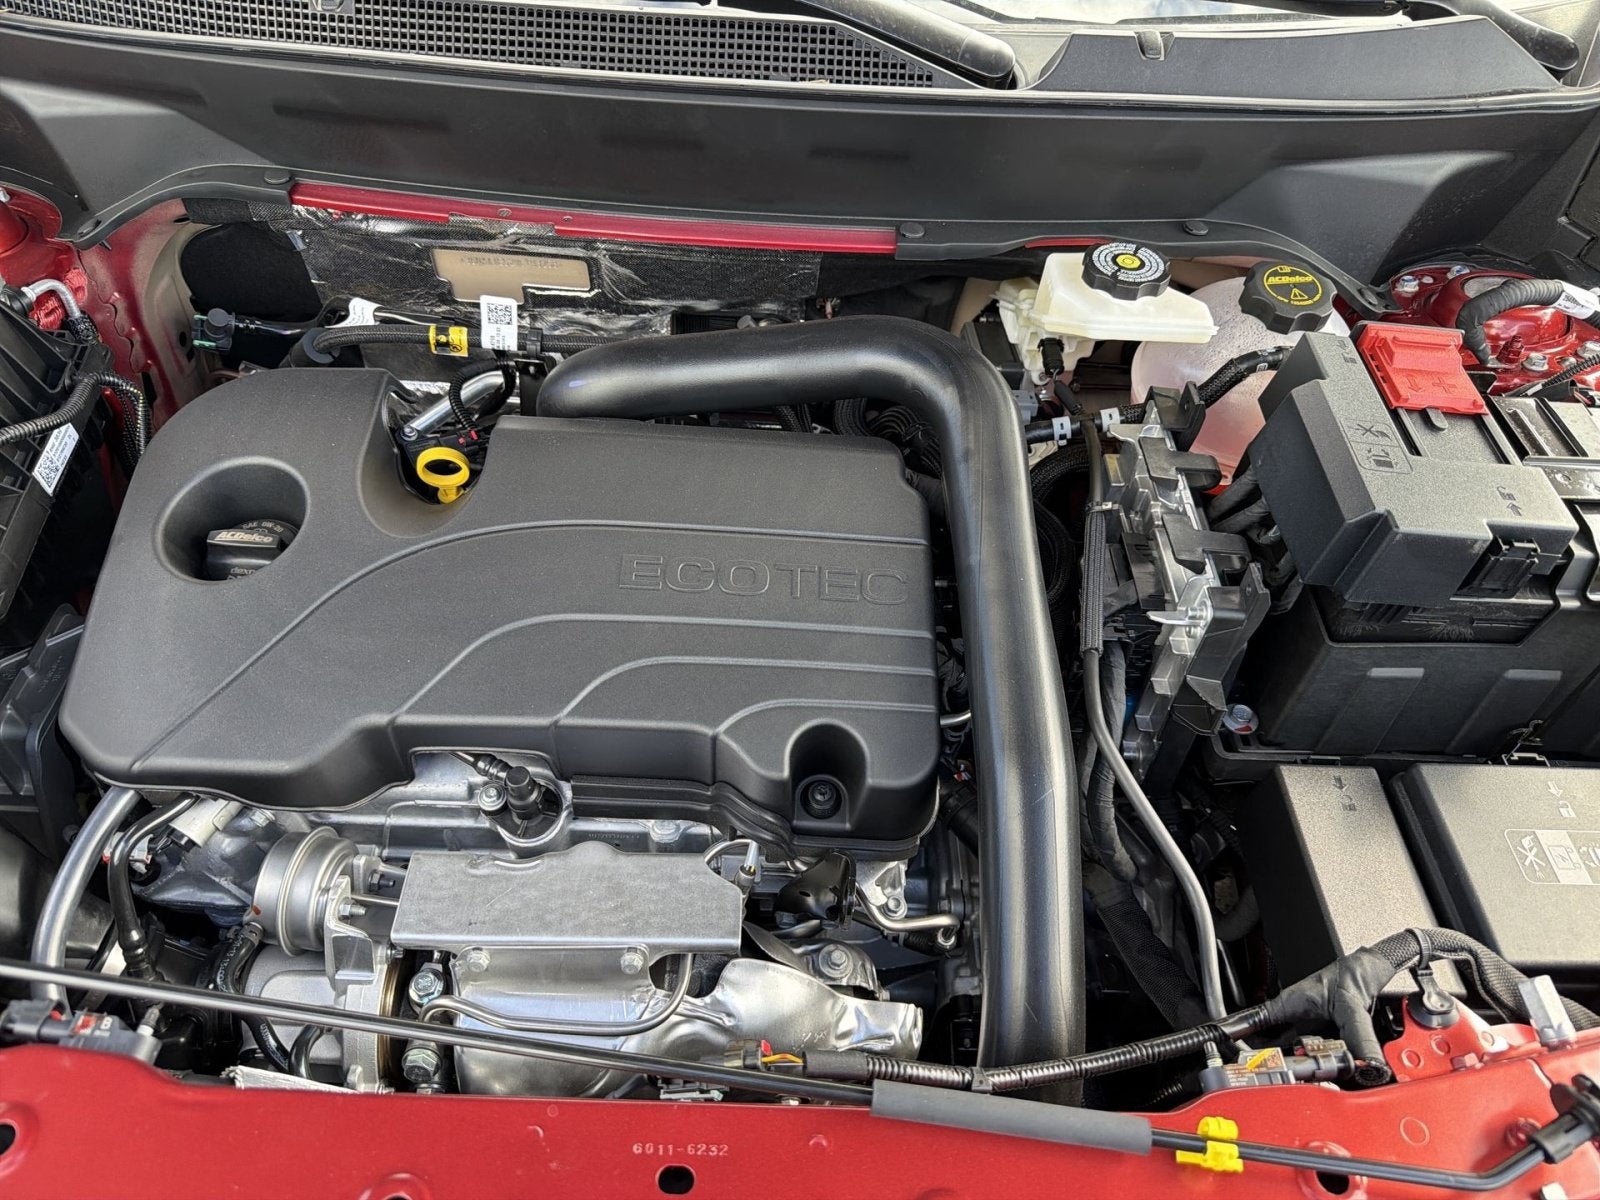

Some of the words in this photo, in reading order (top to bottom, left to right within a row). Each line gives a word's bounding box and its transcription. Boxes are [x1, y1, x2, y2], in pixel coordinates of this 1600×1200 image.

[1267, 276, 1313, 285] ACDelco
[214, 531, 274, 543] ACDelco
[619, 554, 908, 605] ECOTEC
[632, 1143, 729, 1156] 6011-6232
